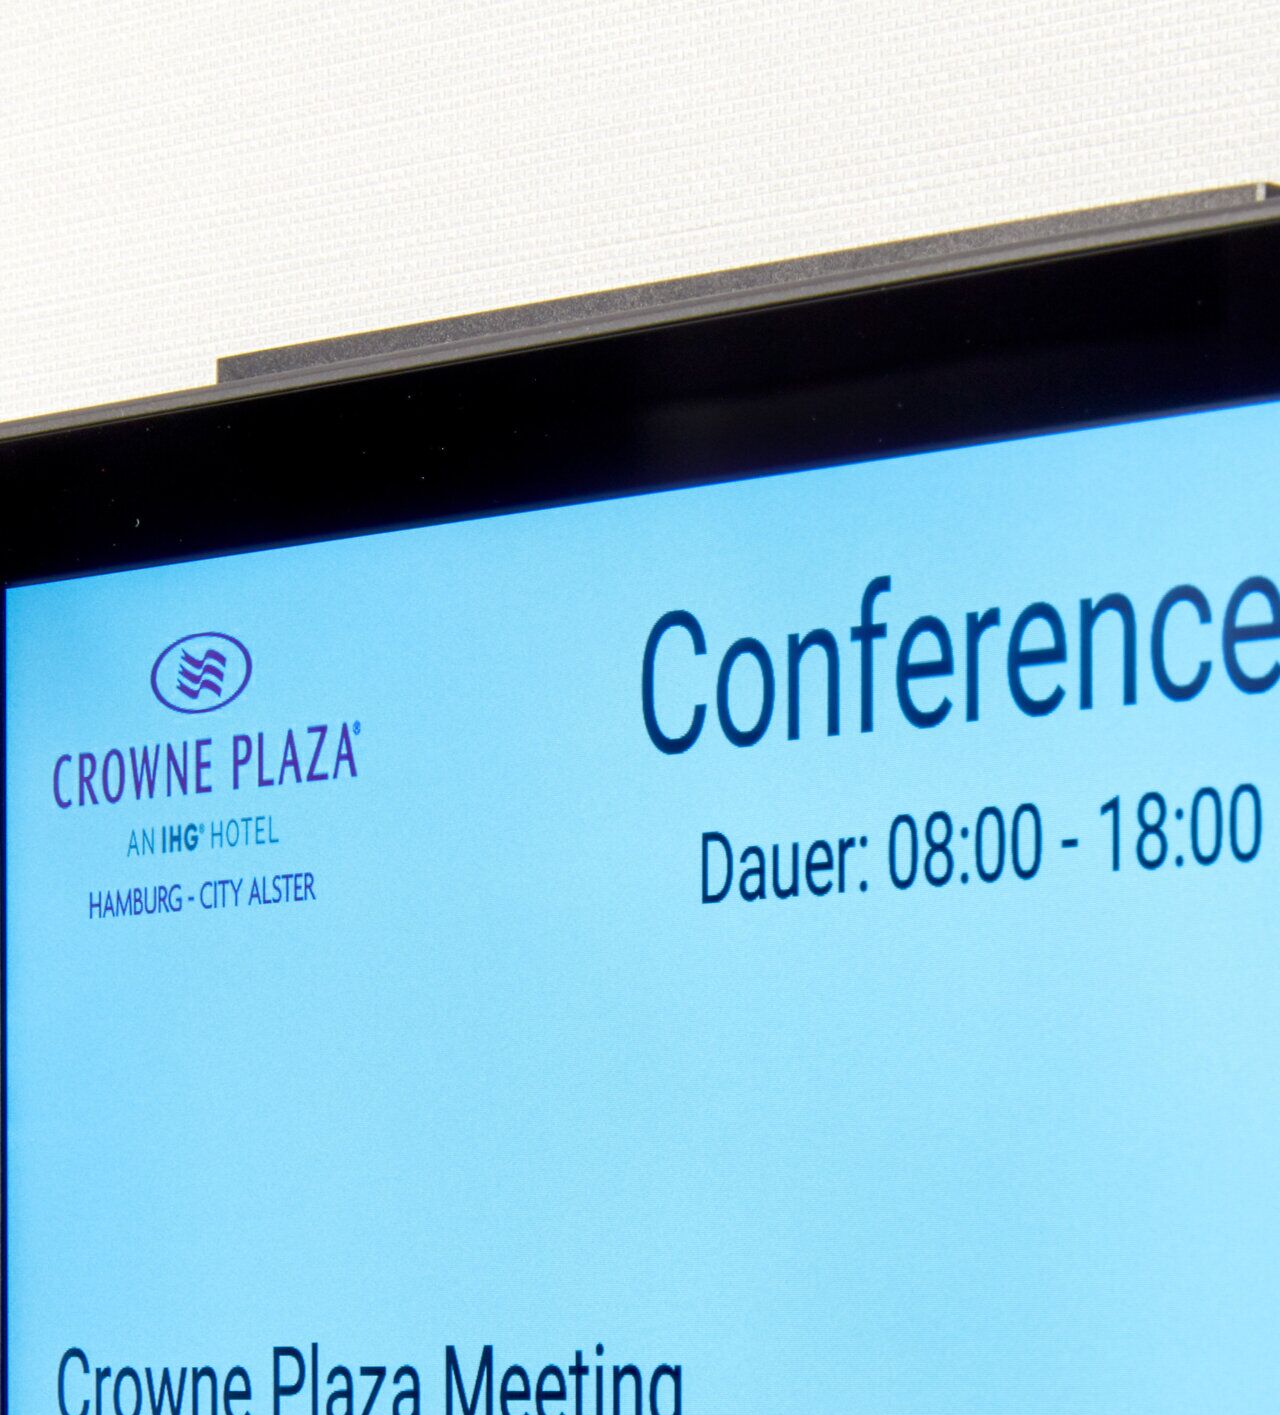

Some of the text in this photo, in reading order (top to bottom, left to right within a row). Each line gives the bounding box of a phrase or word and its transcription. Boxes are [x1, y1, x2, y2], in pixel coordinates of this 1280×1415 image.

[52, 736, 213, 810] CROWNE
[126, 827, 156, 858] AN
[210, 815, 280, 849] HOTEL
[700, 831, 869, 905] Dauer:
[887, 802, 1044, 891] 08:00
[1060, 837, 1080, 849] -
[1099, 783, 1264, 873] 18:00
[88, 883, 183, 920] HAMBURG
[199, 877, 244, 910] CITY
[247, 871, 317, 907] ALSTER
